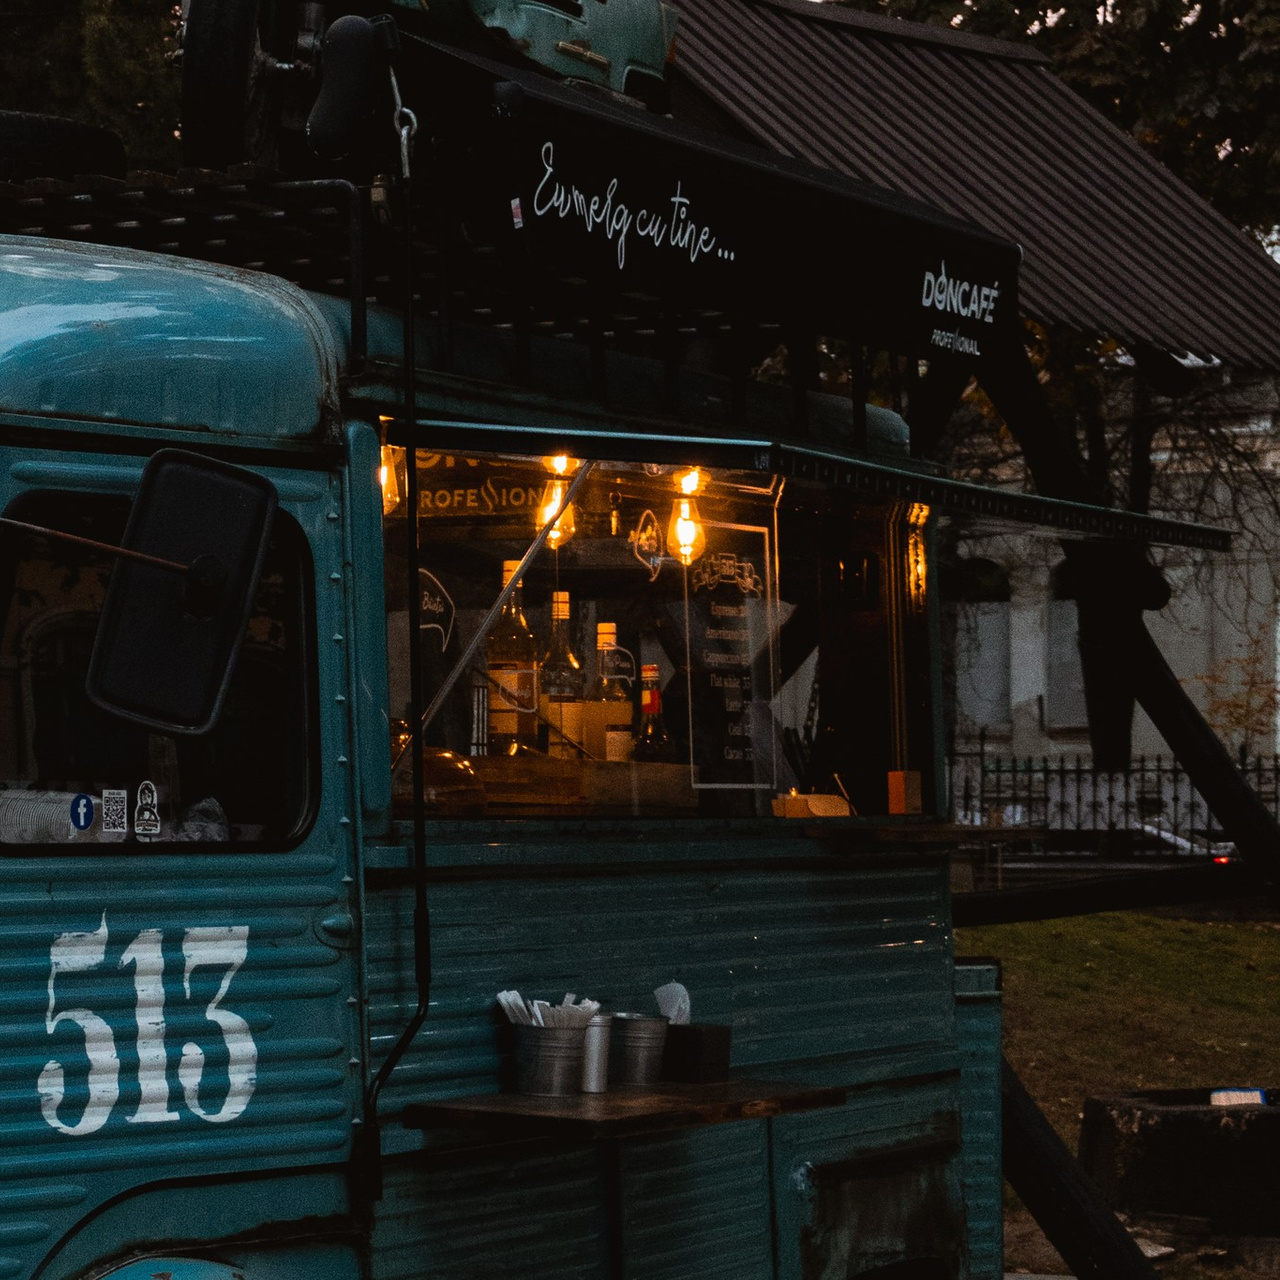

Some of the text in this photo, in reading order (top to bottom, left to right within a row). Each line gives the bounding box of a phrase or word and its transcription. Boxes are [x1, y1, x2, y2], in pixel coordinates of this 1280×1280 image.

[534, 141, 571, 218] Eu
[572, 177, 633, 270] merg
[635, 209, 667, 247] cu
[922, 259, 999, 323] DONCAFÉ
[37, 908, 259, 1136] 513
